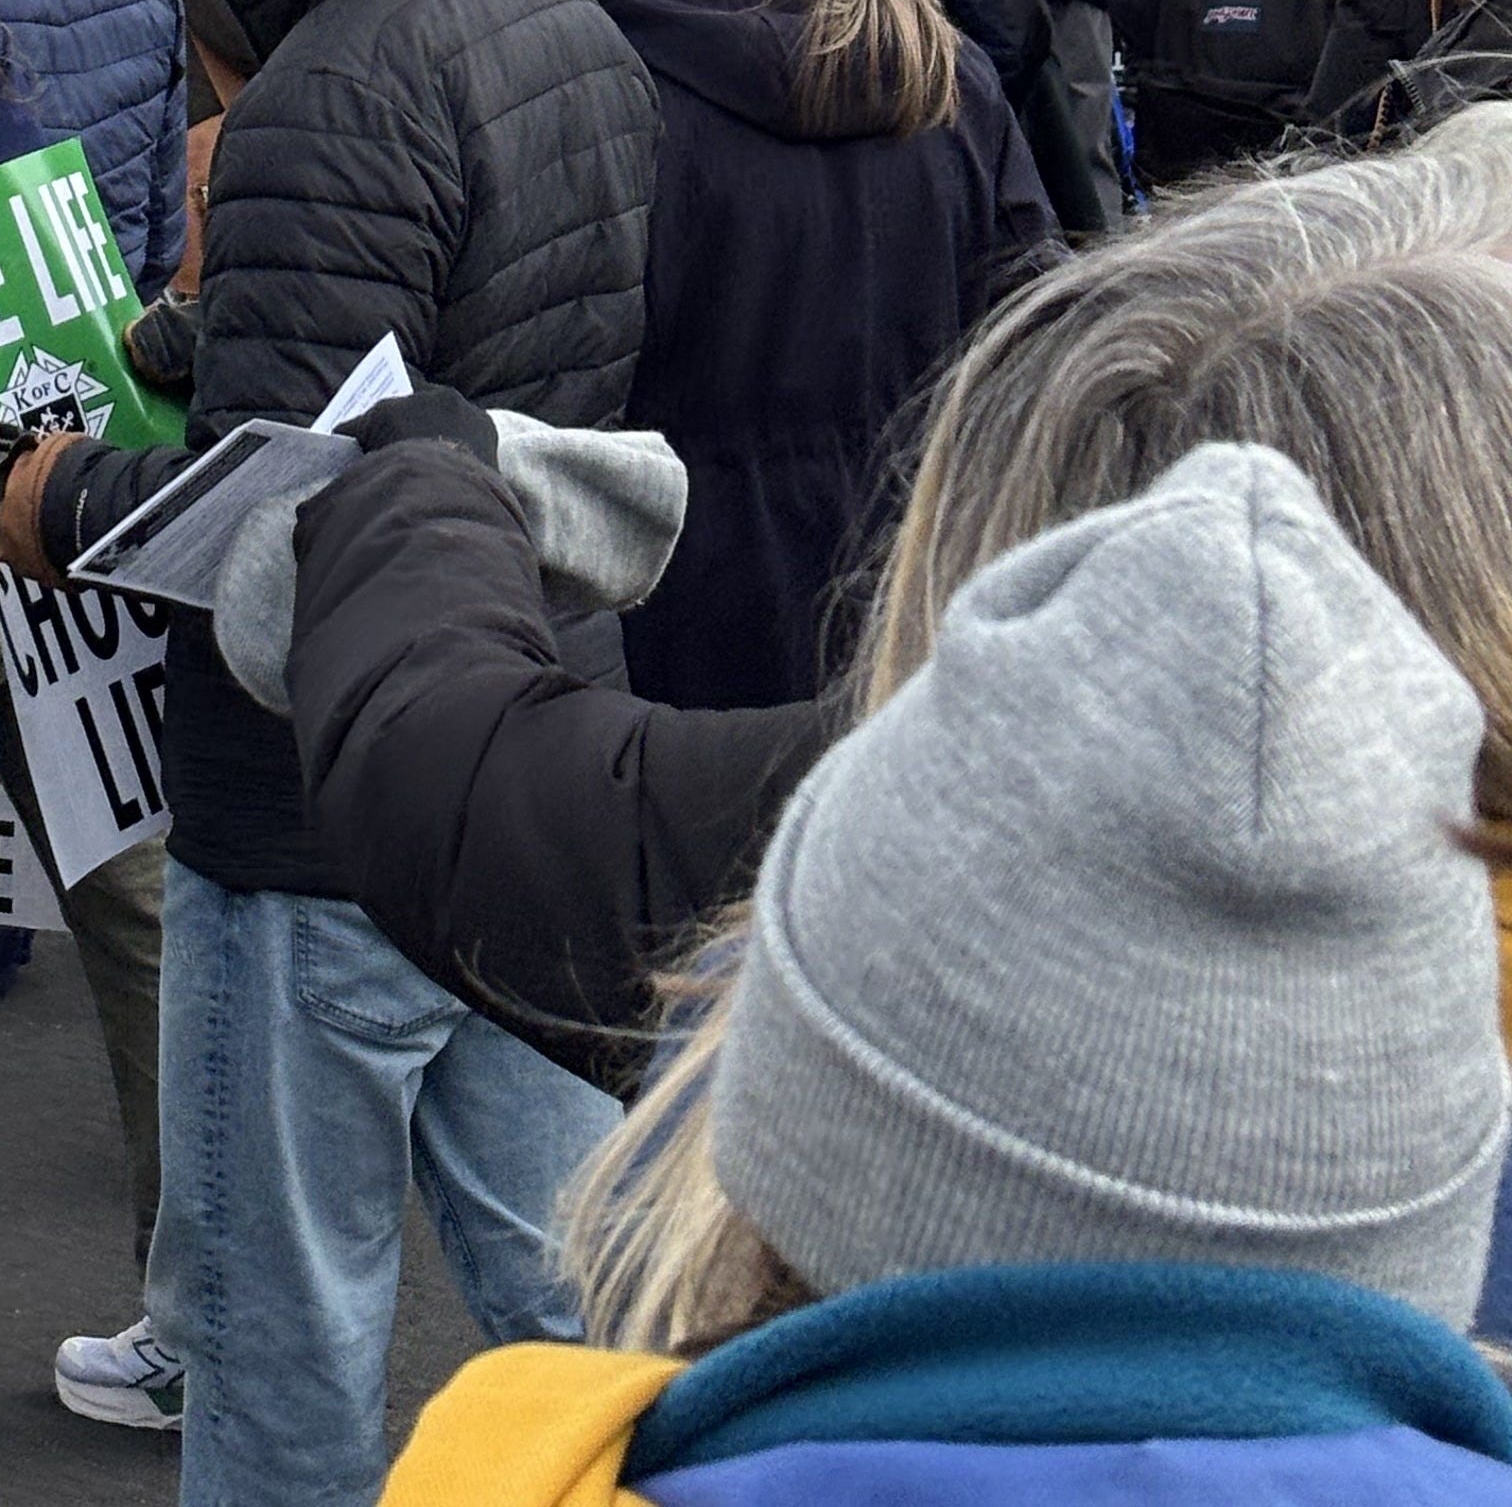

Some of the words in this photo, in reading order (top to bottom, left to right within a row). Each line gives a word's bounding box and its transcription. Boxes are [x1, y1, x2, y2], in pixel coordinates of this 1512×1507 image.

[9, 171, 128, 327] LIFE
[13, 388, 33, 410] K
[31, 382, 51, 400] OF
[54, 372, 72, 393] C
